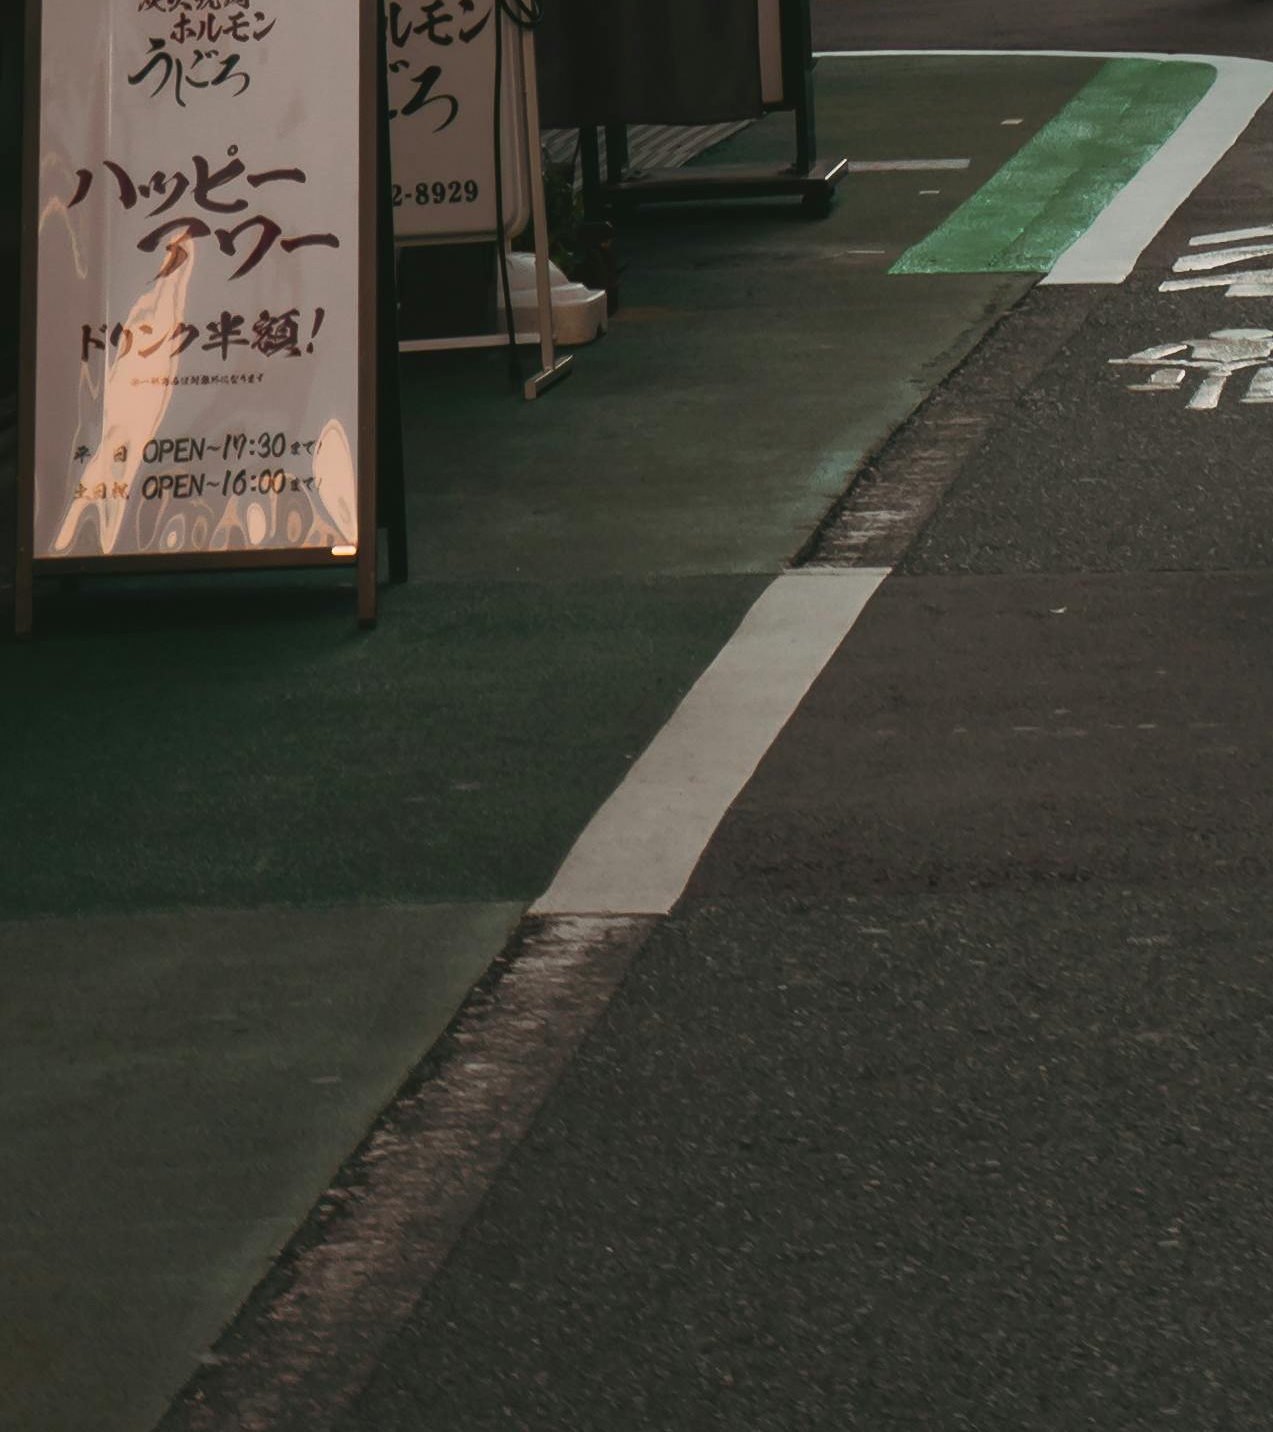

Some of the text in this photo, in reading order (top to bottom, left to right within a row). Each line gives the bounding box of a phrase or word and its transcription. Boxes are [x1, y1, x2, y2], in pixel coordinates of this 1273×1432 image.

[169, 10, 277, 44] ホルモン
[127, 37, 251, 108] うしごろ
[66, 144, 307, 219] ハッピー
[136, 213, 340, 282] アワー
